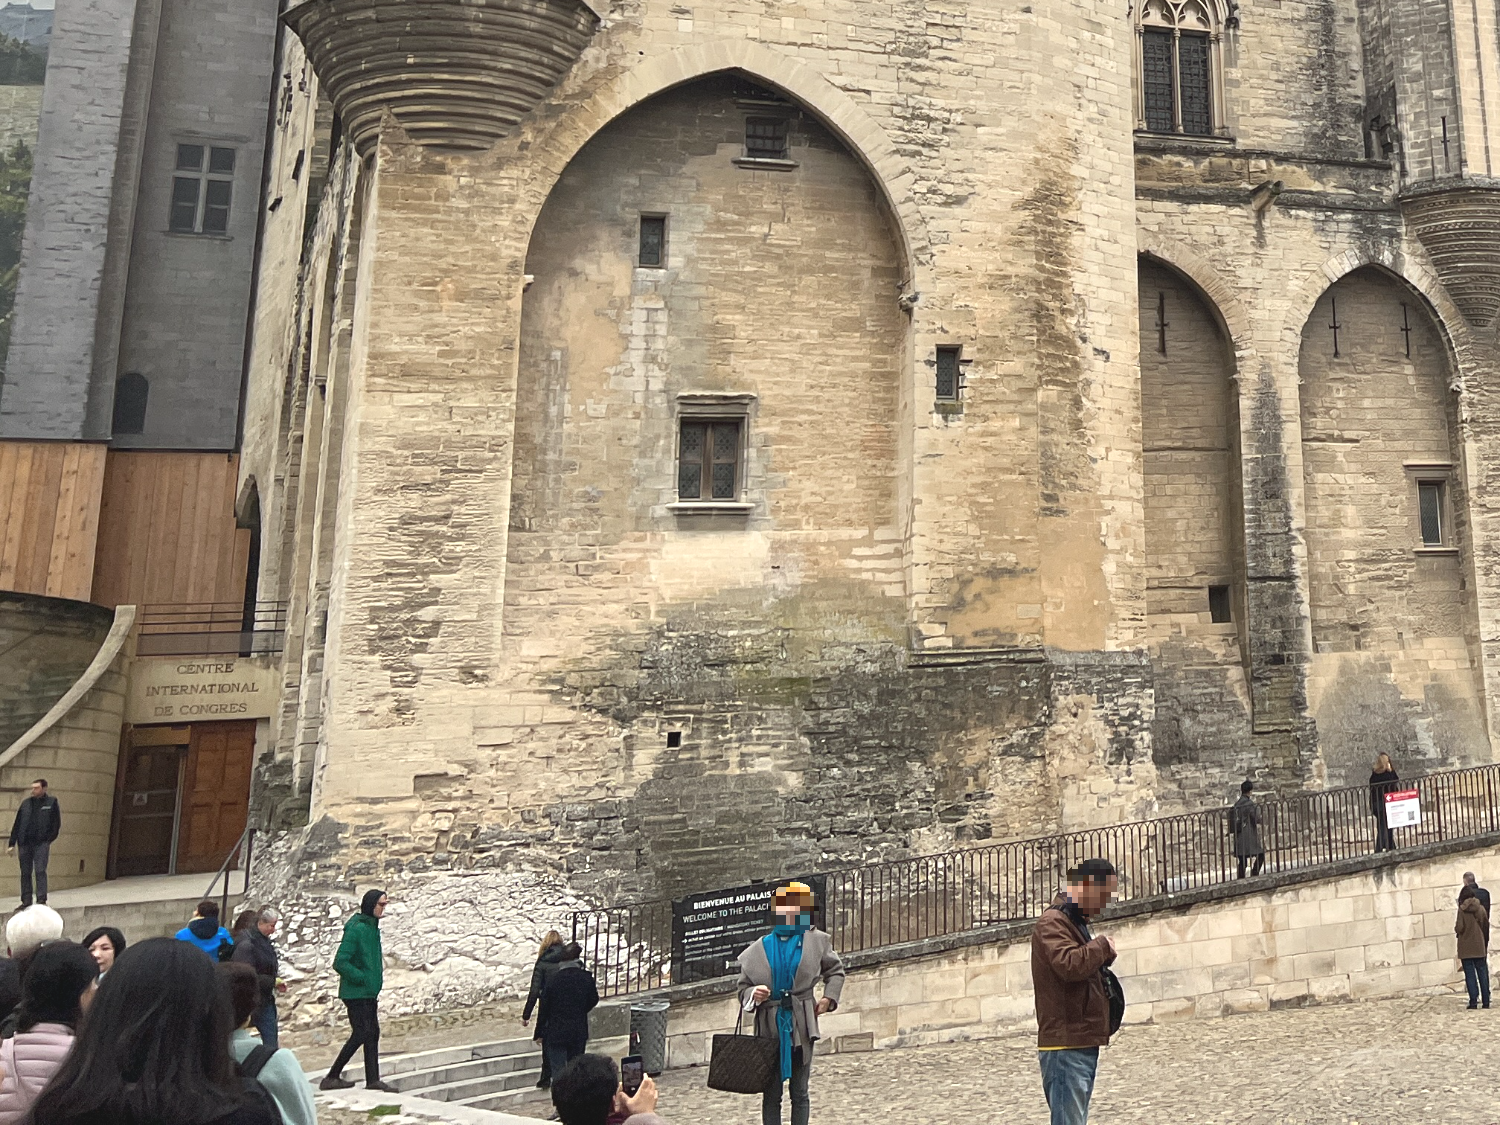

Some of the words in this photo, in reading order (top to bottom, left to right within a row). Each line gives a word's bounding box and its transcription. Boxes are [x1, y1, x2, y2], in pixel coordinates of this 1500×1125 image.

[177, 663, 234, 675] CENTRE
[146, 682, 259, 696] INTERNATIONAL
[154, 706, 173, 716] DE
[179, 703, 248, 715] CONGRES
[693, 897, 734, 910] BIENVENUE
[735, 895, 746, 903] AU
[746, 890, 771, 901] PALAIS
[683, 911, 717, 923] WELCOME
[719, 909, 727, 917] TO
[729, 907, 743, 916] THE
